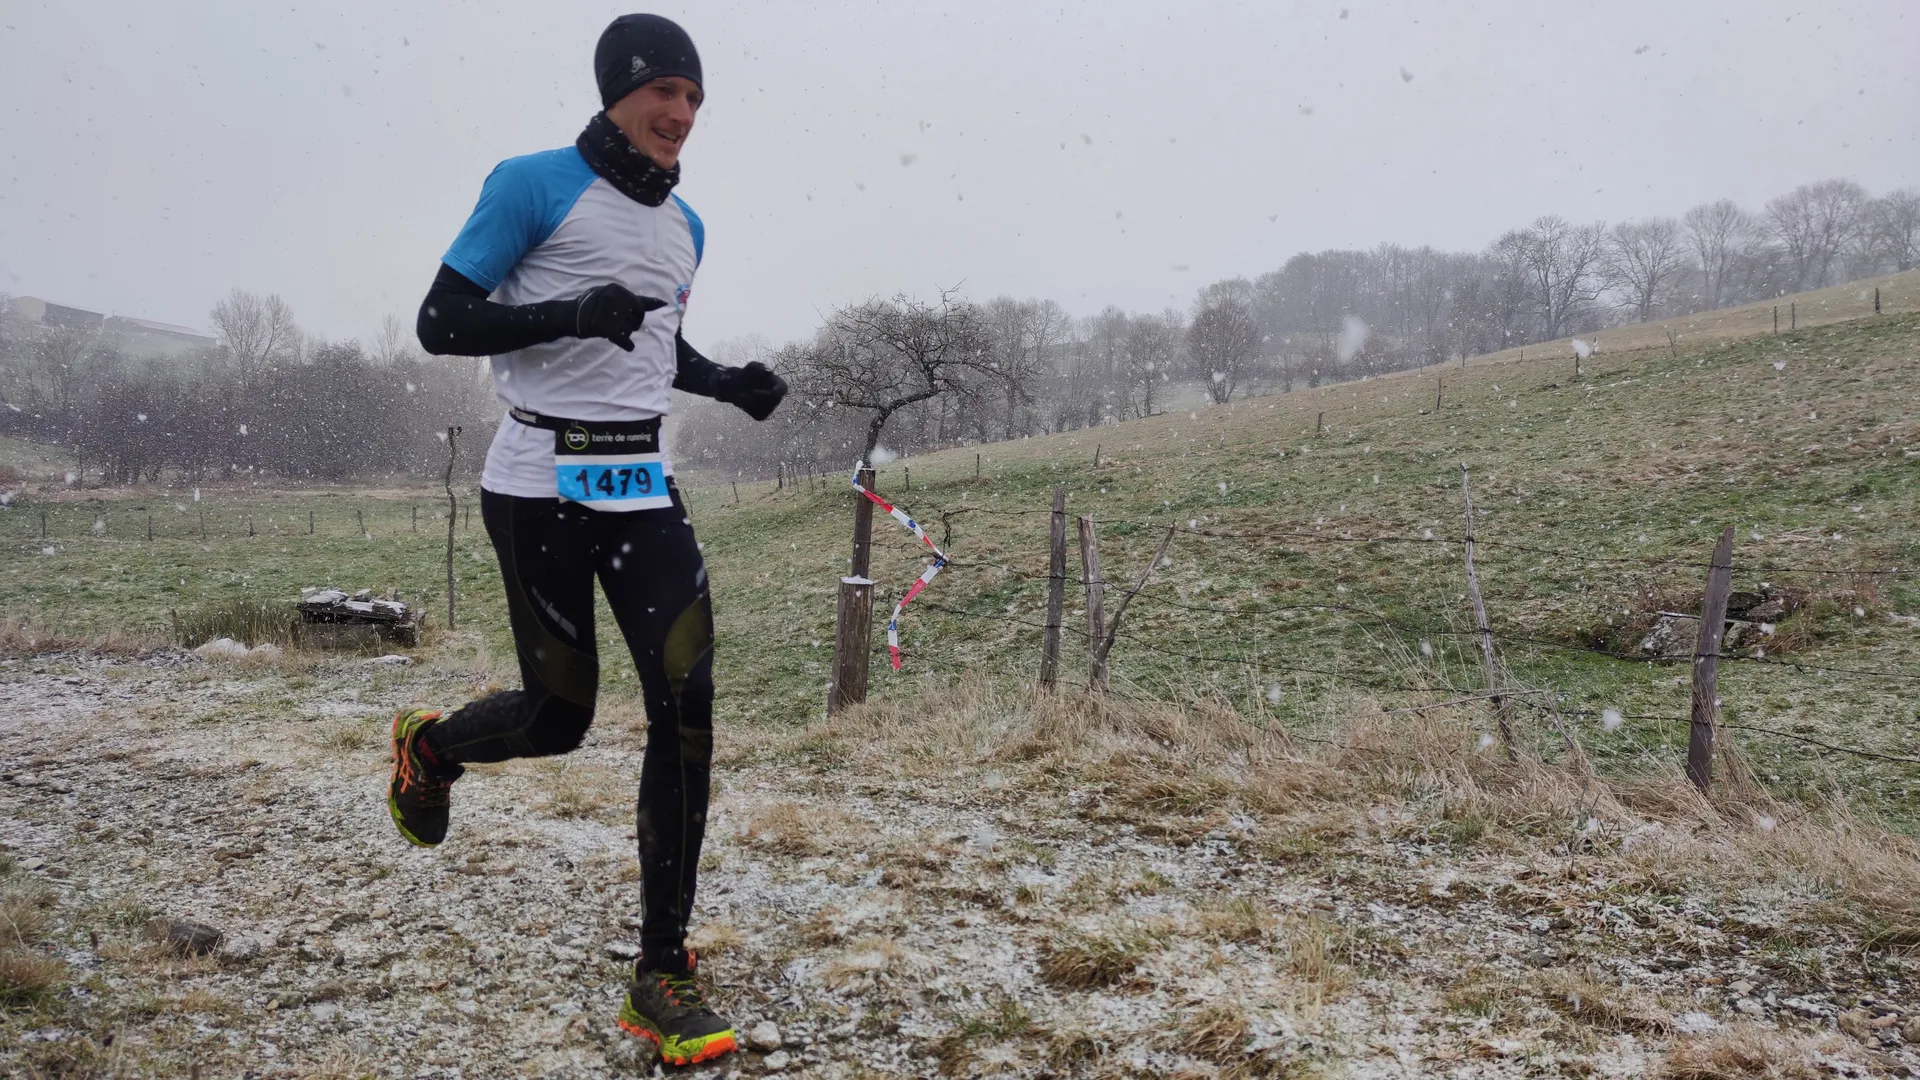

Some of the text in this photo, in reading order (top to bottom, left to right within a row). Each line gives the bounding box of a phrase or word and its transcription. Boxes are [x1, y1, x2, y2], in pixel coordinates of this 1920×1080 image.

[592, 433, 652, 443] terre de running
[575, 467, 652, 497] 1479
